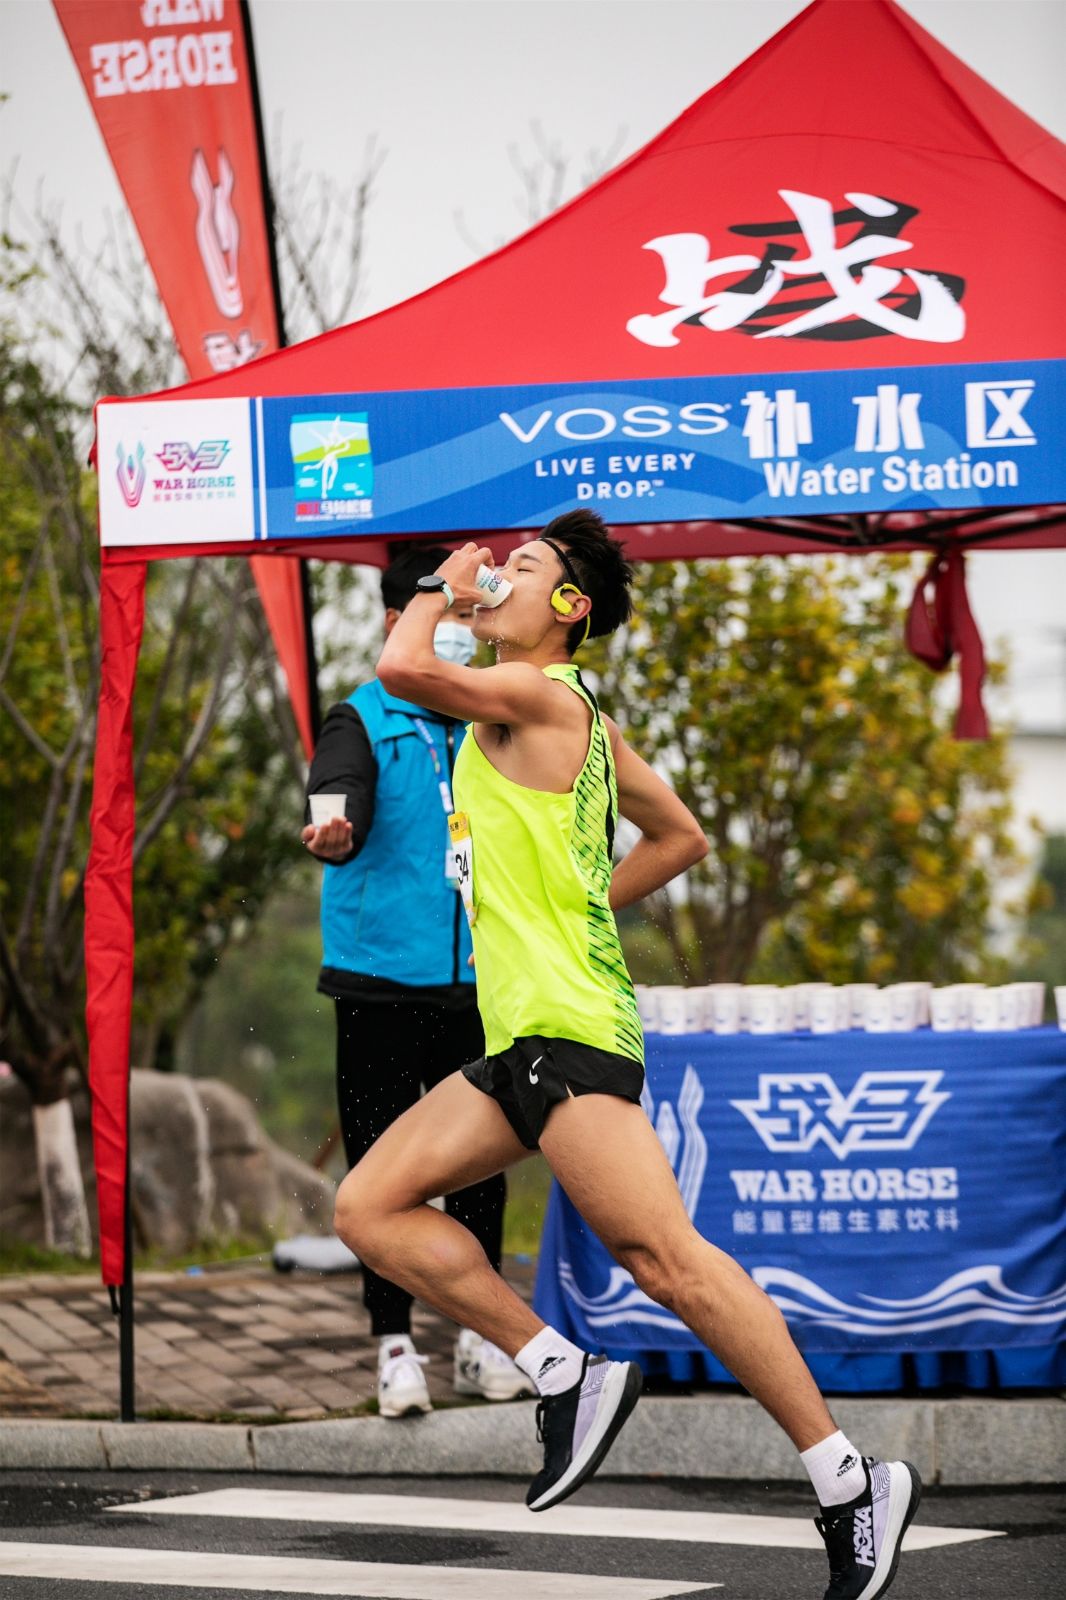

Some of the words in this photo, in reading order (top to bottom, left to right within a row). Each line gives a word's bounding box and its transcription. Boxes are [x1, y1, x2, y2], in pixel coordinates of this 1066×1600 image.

[499, 402, 730, 443] VOSS
[740, 379, 1038, 459] 补水区
[153, 479, 183, 490] WAR
[187, 476, 236, 489] HORSE
[535, 457, 595, 477] LIVE
[608, 453, 696, 474] EVERY
[762, 460, 875, 498] Water
[882, 453, 1019, 493] Station
[729, 1169, 818, 1203] WAR
[820, 1166, 960, 1202] HORSE
[732, 1206, 960, 1235] 能量型维生素饮料
[853, 1505, 876, 1568] HOKA
